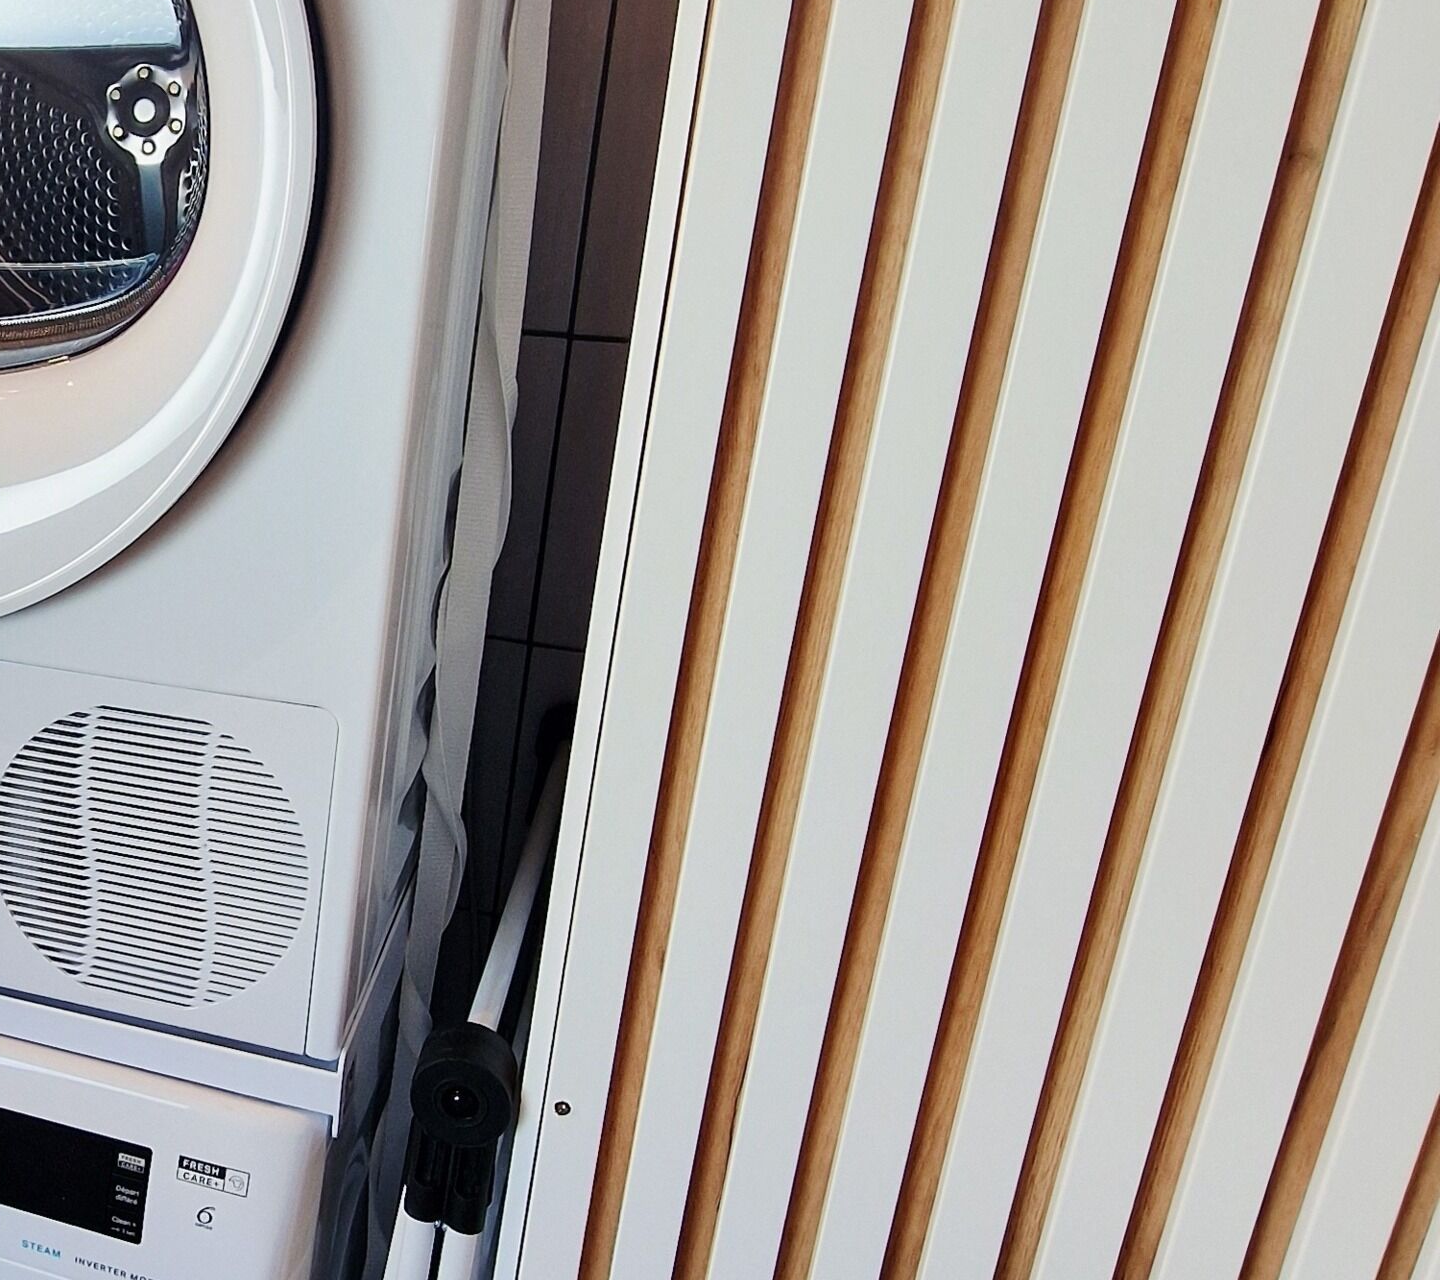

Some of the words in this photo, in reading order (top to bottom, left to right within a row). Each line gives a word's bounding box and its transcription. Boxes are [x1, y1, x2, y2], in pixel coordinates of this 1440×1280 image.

[182, 1158, 220, 1177] FRESH
[182, 1172, 219, 1188] CARE+
[22, 1239, 61, 1258] STEAM
[74, 1256, 127, 1279] INVERTER
